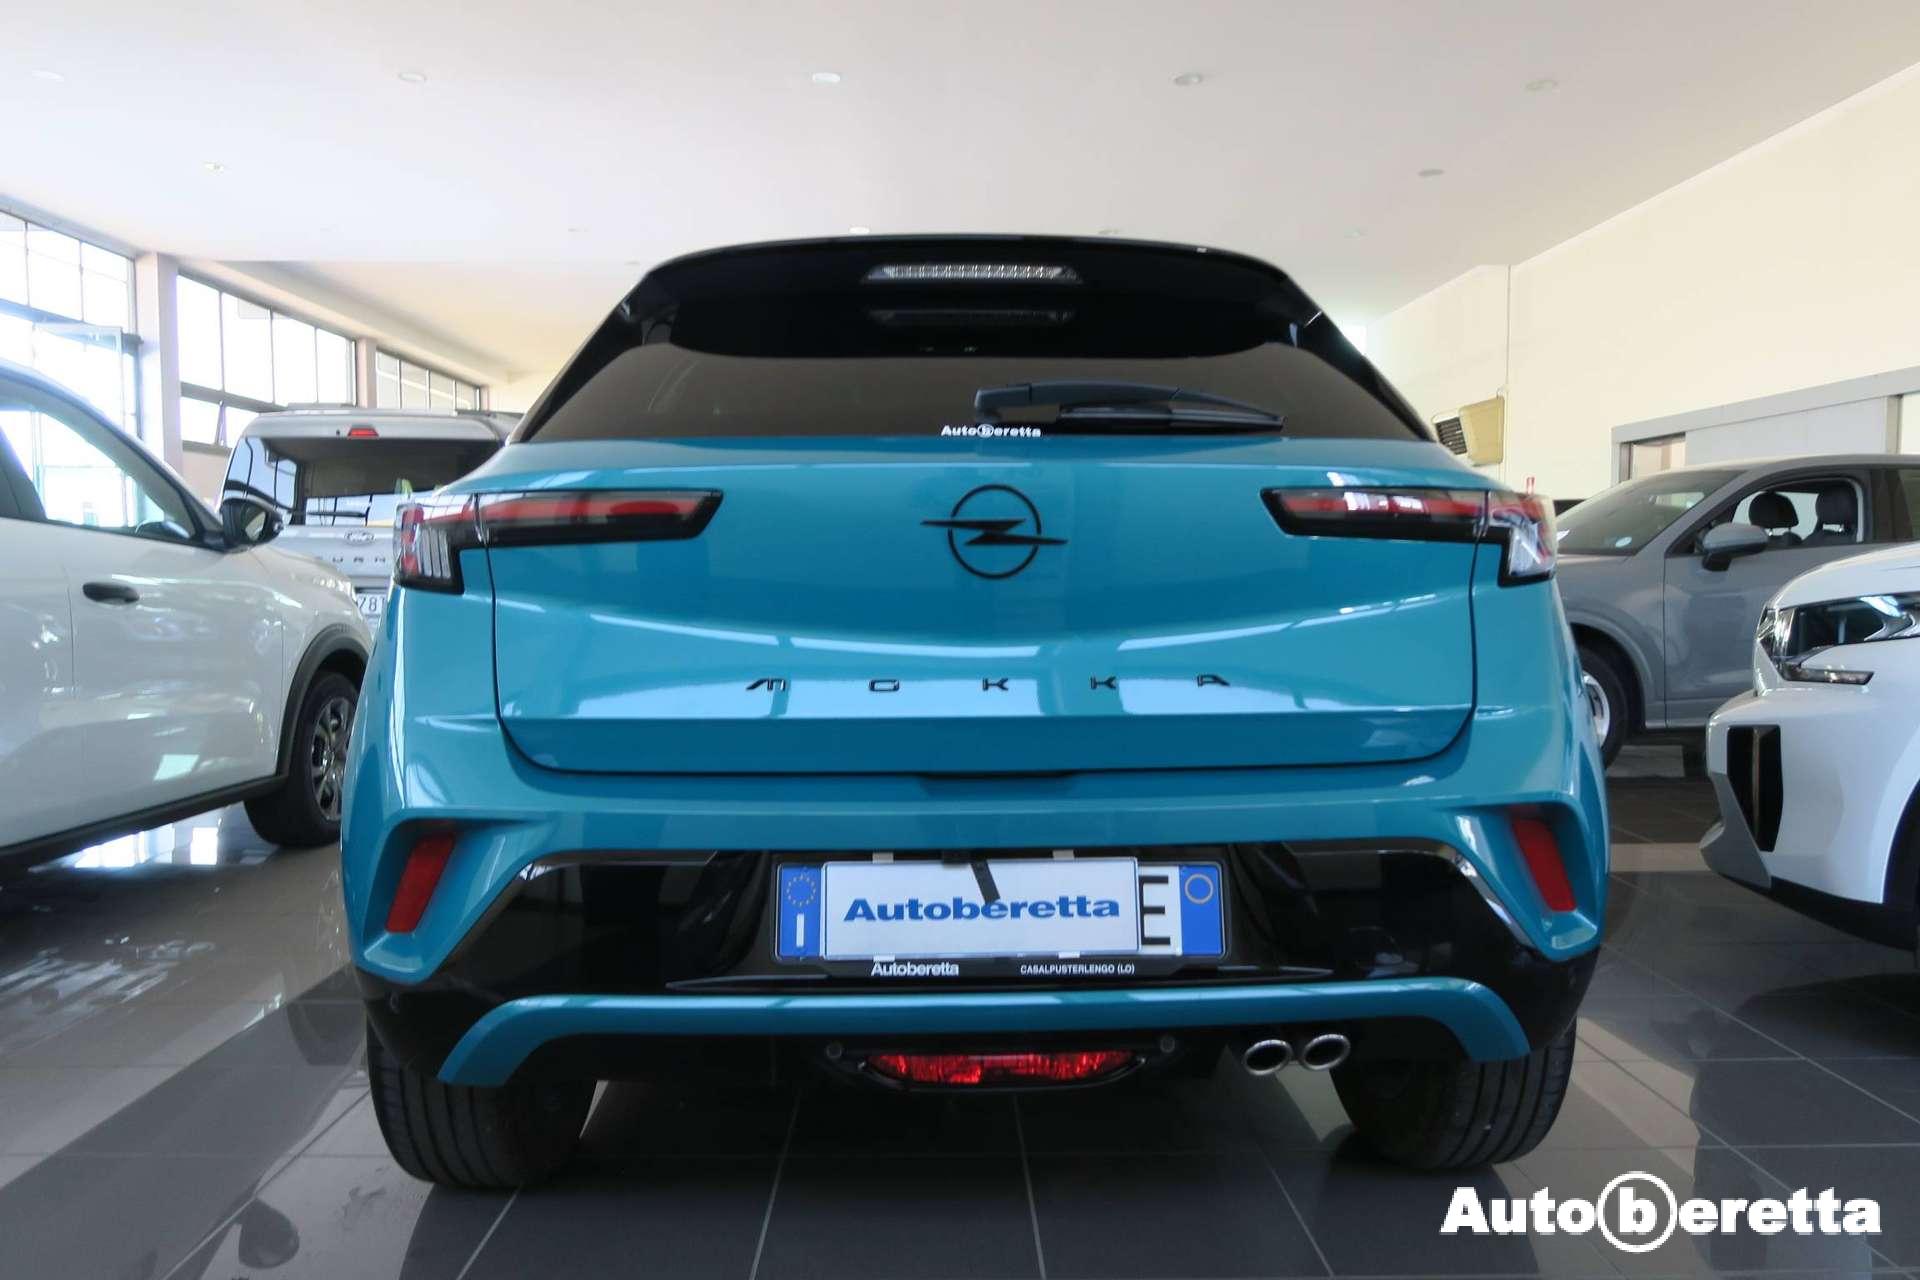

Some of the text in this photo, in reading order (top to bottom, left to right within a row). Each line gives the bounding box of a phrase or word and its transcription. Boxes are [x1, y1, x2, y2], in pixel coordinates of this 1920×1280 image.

[940, 424, 1041, 438] Autoberetta
[746, 676, 1230, 692] MOKKA
[843, 895, 1120, 921] Autoberetta
[870, 960, 960, 976] Autoberetta
